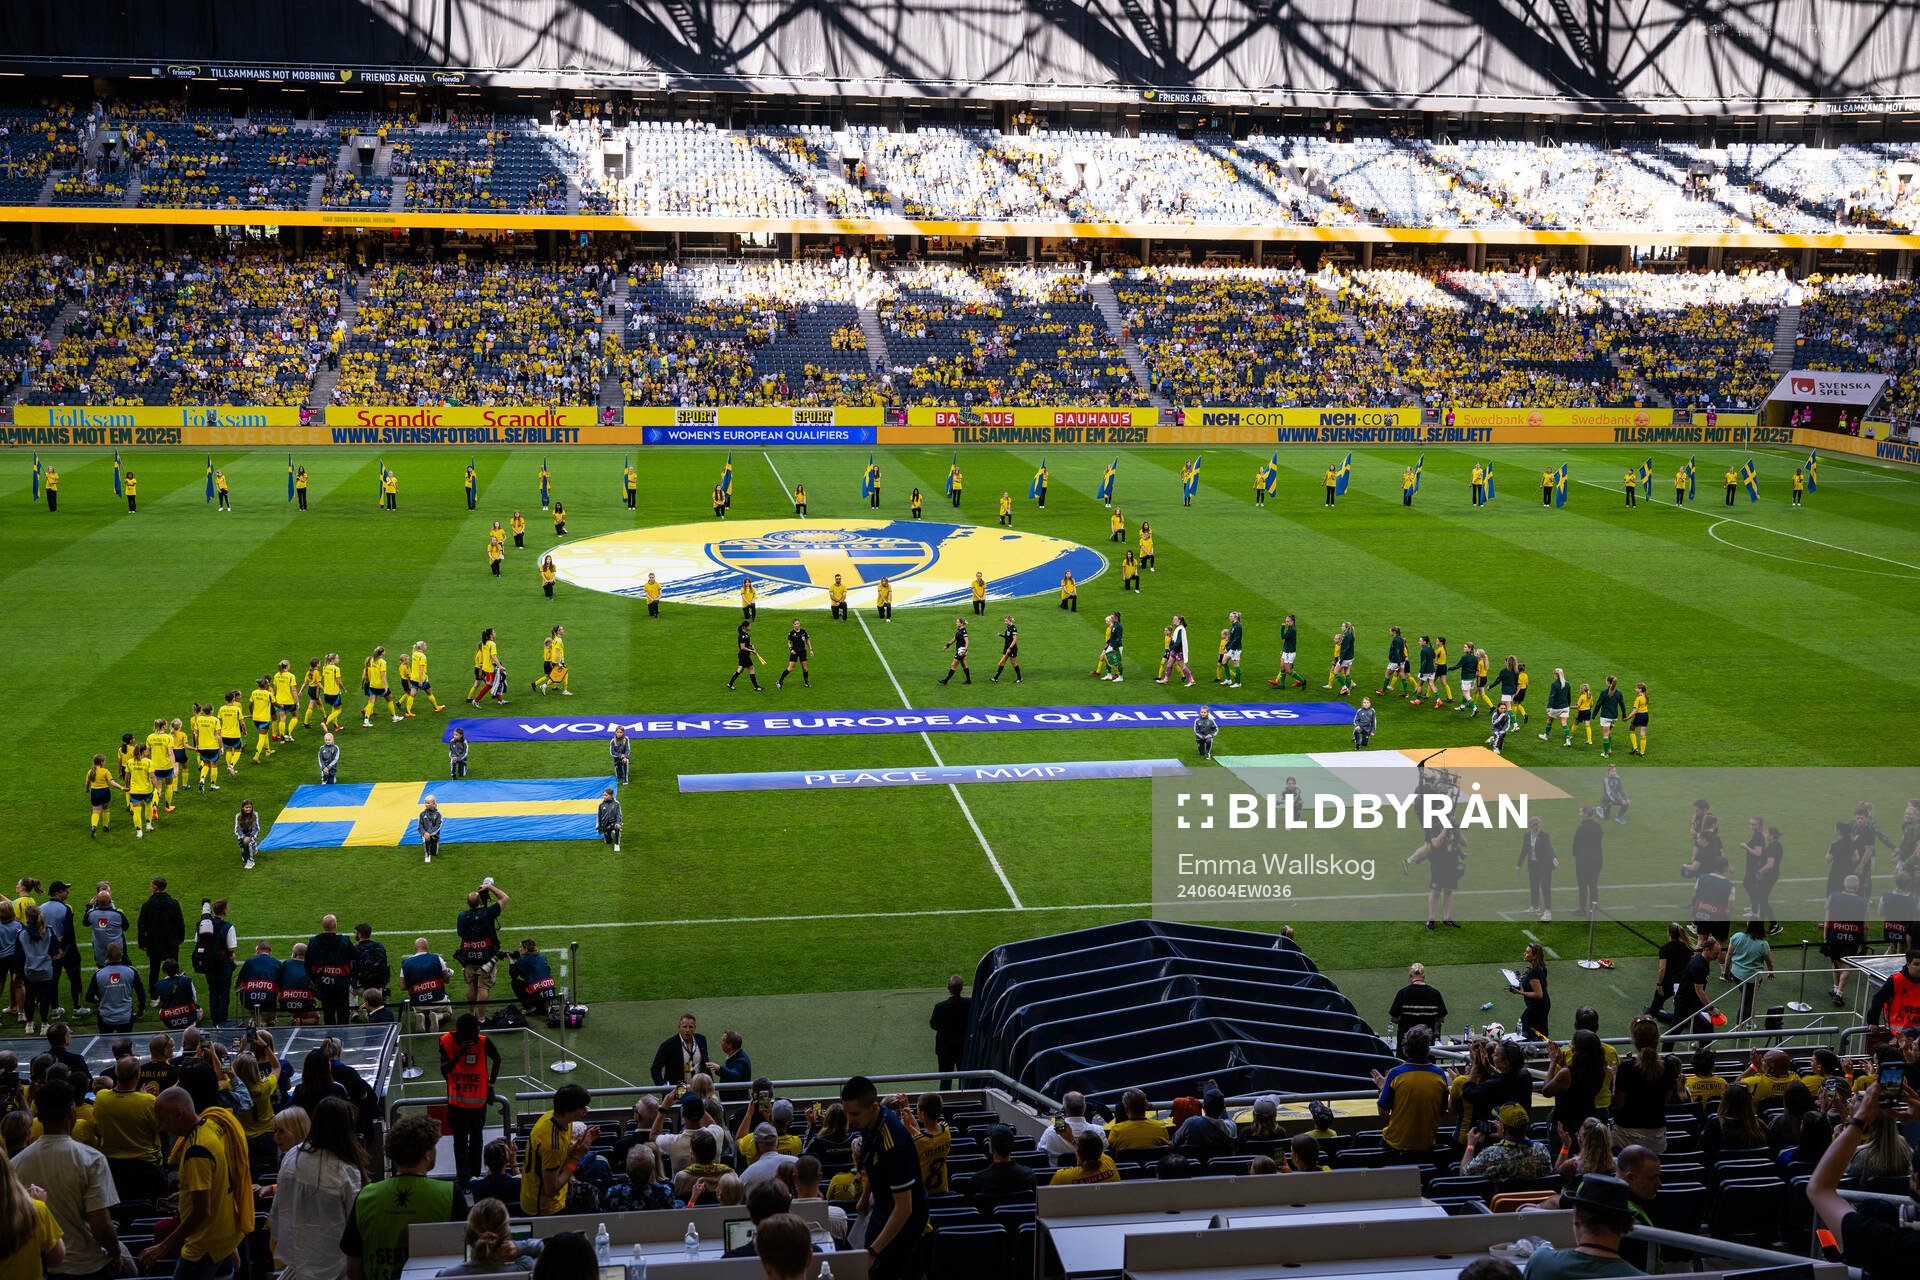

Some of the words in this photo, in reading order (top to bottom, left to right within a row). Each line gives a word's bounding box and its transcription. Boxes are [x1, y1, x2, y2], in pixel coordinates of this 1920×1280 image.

[211, 68, 270, 79] TILLSAMMANS
[272, 70, 290, 79] MOT
[292, 70, 335, 80] MOBBNING
[361, 72, 396, 82] FRIENDS
[398, 74, 426, 83] ARENA
[1158, 93, 1190, 102] FRIENDS
[1191, 94, 1216, 103] ARENA
[1827, 102, 1884, 113] TILLSAMMANS
[1885, 101, 1903, 112] MOT
[1819, 382, 1871, 390] SVENSKA
[1819, 389, 1847, 397] SPEL
[48, 409, 135, 427] Folksam
[357, 409, 443, 427] Scandic
[483, 409, 567, 427] Scandic
[677, 410, 717, 424] SPORT
[794, 410, 833, 423] SPORT
[936, 413, 1014, 425] BAAUS
[1055, 413, 1131, 425] BAUHAUS
[1463, 414, 1524, 425] Swedbank
[1571, 414, 1631, 426] Swedbank
[72, 427, 107, 444] MOT
[109, 427, 132, 444] EM
[135, 427, 182, 444] 2025!
[331, 427, 580, 444] WWW.SVENSKFOTBOLL.SE/BILJETT
[723, 430, 783, 440] EUROPEAN
[785, 430, 849, 441] QUALIFIERS
[953, 427, 1051, 443] TILLSAMMANS
[1054, 427, 1084, 443] MOT
[1086, 427, 1106, 443] EM
[1108, 427, 1148, 443] 2025!
[1277, 427, 1492, 443] WWW.SVENSKFOTBOLL.SE/BILJETT
[1614, 427, 1702, 442] TILLSAMMANS
[1704, 427, 1732, 442] MOT
[1733, 427, 1751, 442] EM
[1753, 427, 1794, 443] 2025!
[764, 713, 1022, 730] EUROPEAN
[803, 770, 934, 785] PEACE
[1833, 922, 1859, 932] PHOTO
[463, 940, 487, 950] PHOTO
[247, 981, 273, 991] PHOTO
[413, 981, 436, 992] PHOTO
[533, 978, 555, 990] PHOTO
[283, 990, 308, 999] PHOTO
[164, 1006, 190, 1017] PHOTO
